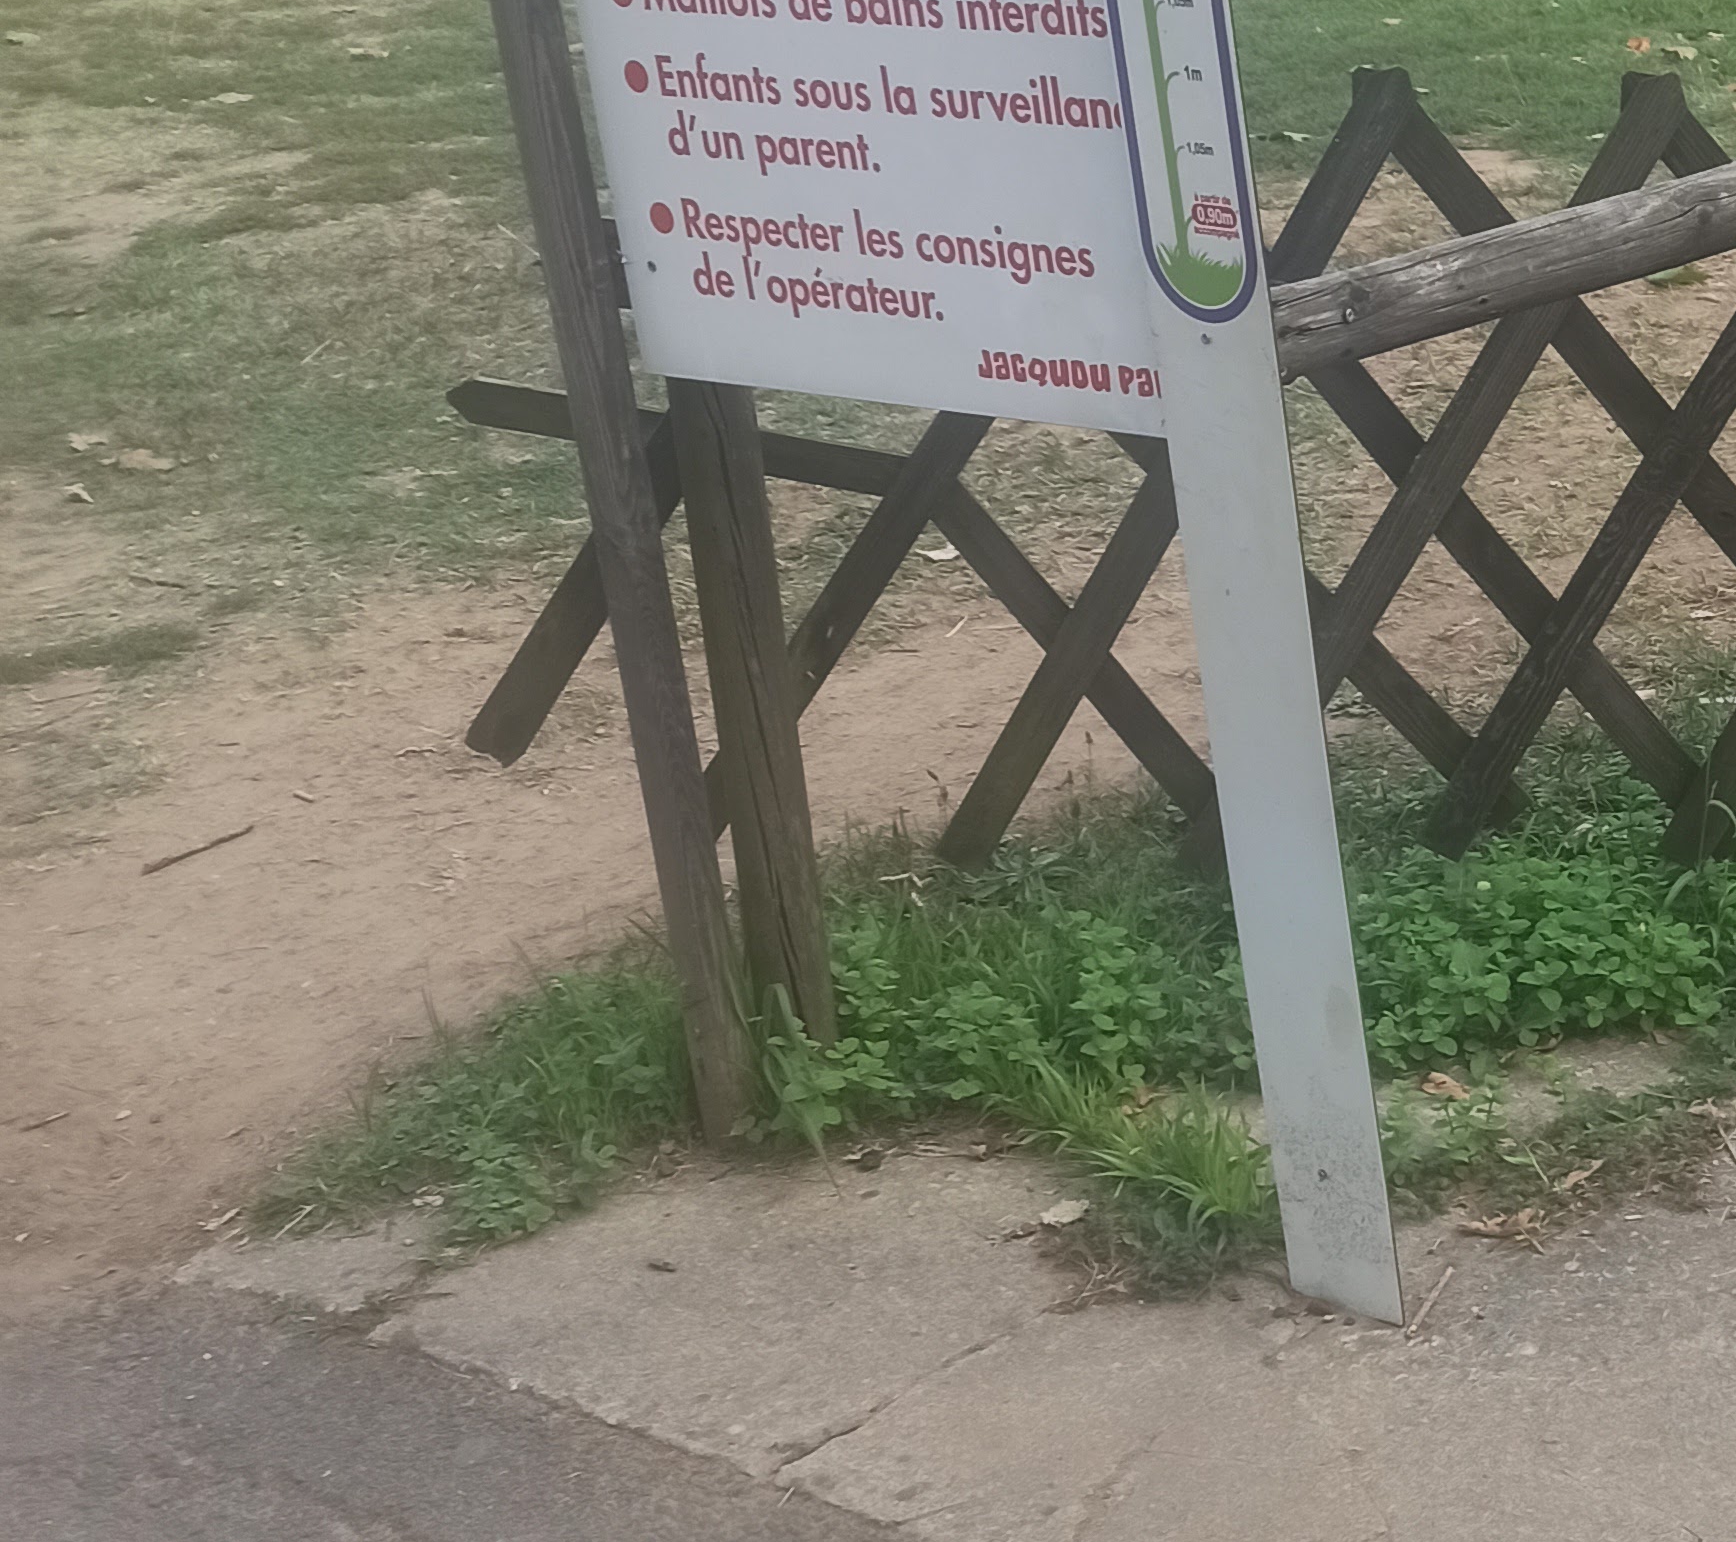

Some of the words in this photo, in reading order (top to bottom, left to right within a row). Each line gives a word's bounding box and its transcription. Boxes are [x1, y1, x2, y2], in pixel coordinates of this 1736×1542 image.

[654, 53, 780, 105] Enfants
[794, 72, 871, 112] sous
[880, 66, 916, 115] la
[1184, 65, 1202, 82] 1m
[668, 110, 744, 160] d'un
[757, 128, 880, 175] parent.
[681, 198, 843, 257] Respecter
[854, 209, 904, 261] les
[916, 226, 1094, 283] consignes
[1196, 206, 1234, 226] 0,90m
[692, 253, 735, 299] de
[742, 256, 943, 321] l'opérateur.
